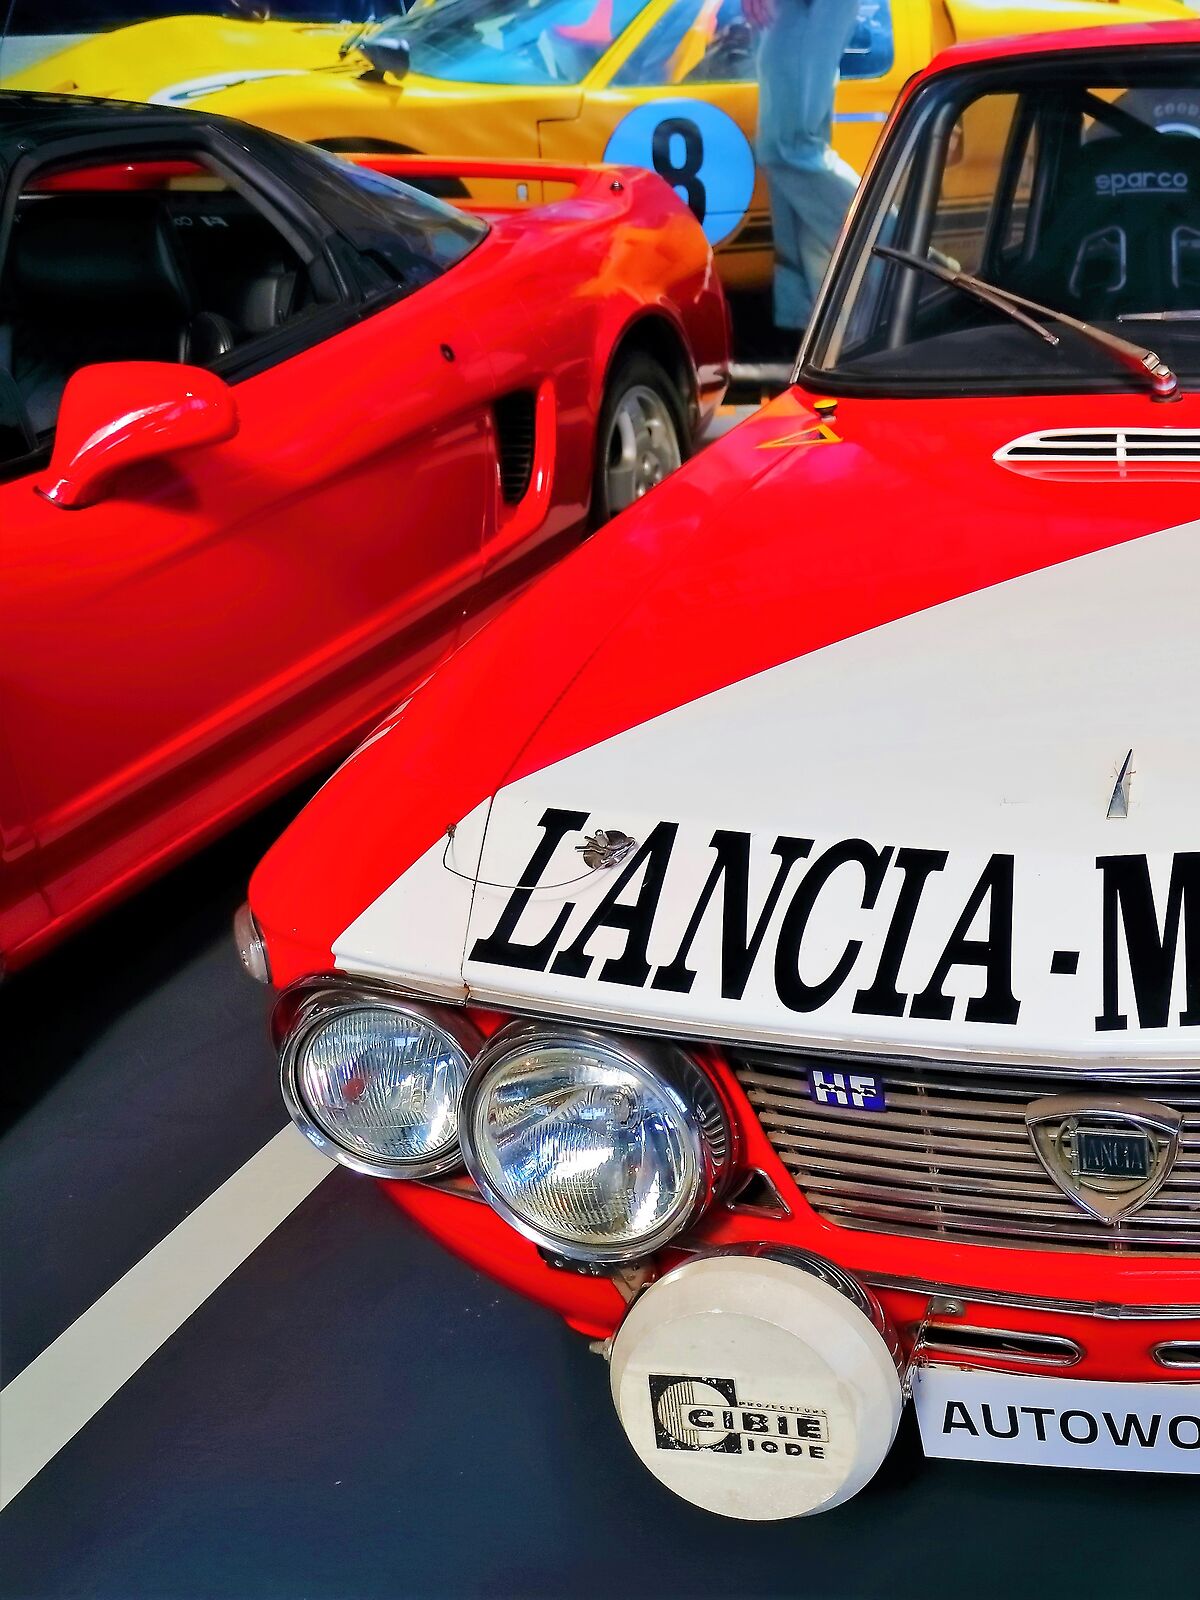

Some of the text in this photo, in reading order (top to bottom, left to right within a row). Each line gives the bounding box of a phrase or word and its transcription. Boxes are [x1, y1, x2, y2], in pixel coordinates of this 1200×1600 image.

[653, 118, 706, 226] 8
[1095, 171, 1188, 196] sparco
[467, 807, 1021, 1026] LANCIA
[812, 1070, 878, 1108] HF
[1079, 1134, 1144, 1172] LANCIA
[748, 1438, 825, 1459] IODE
